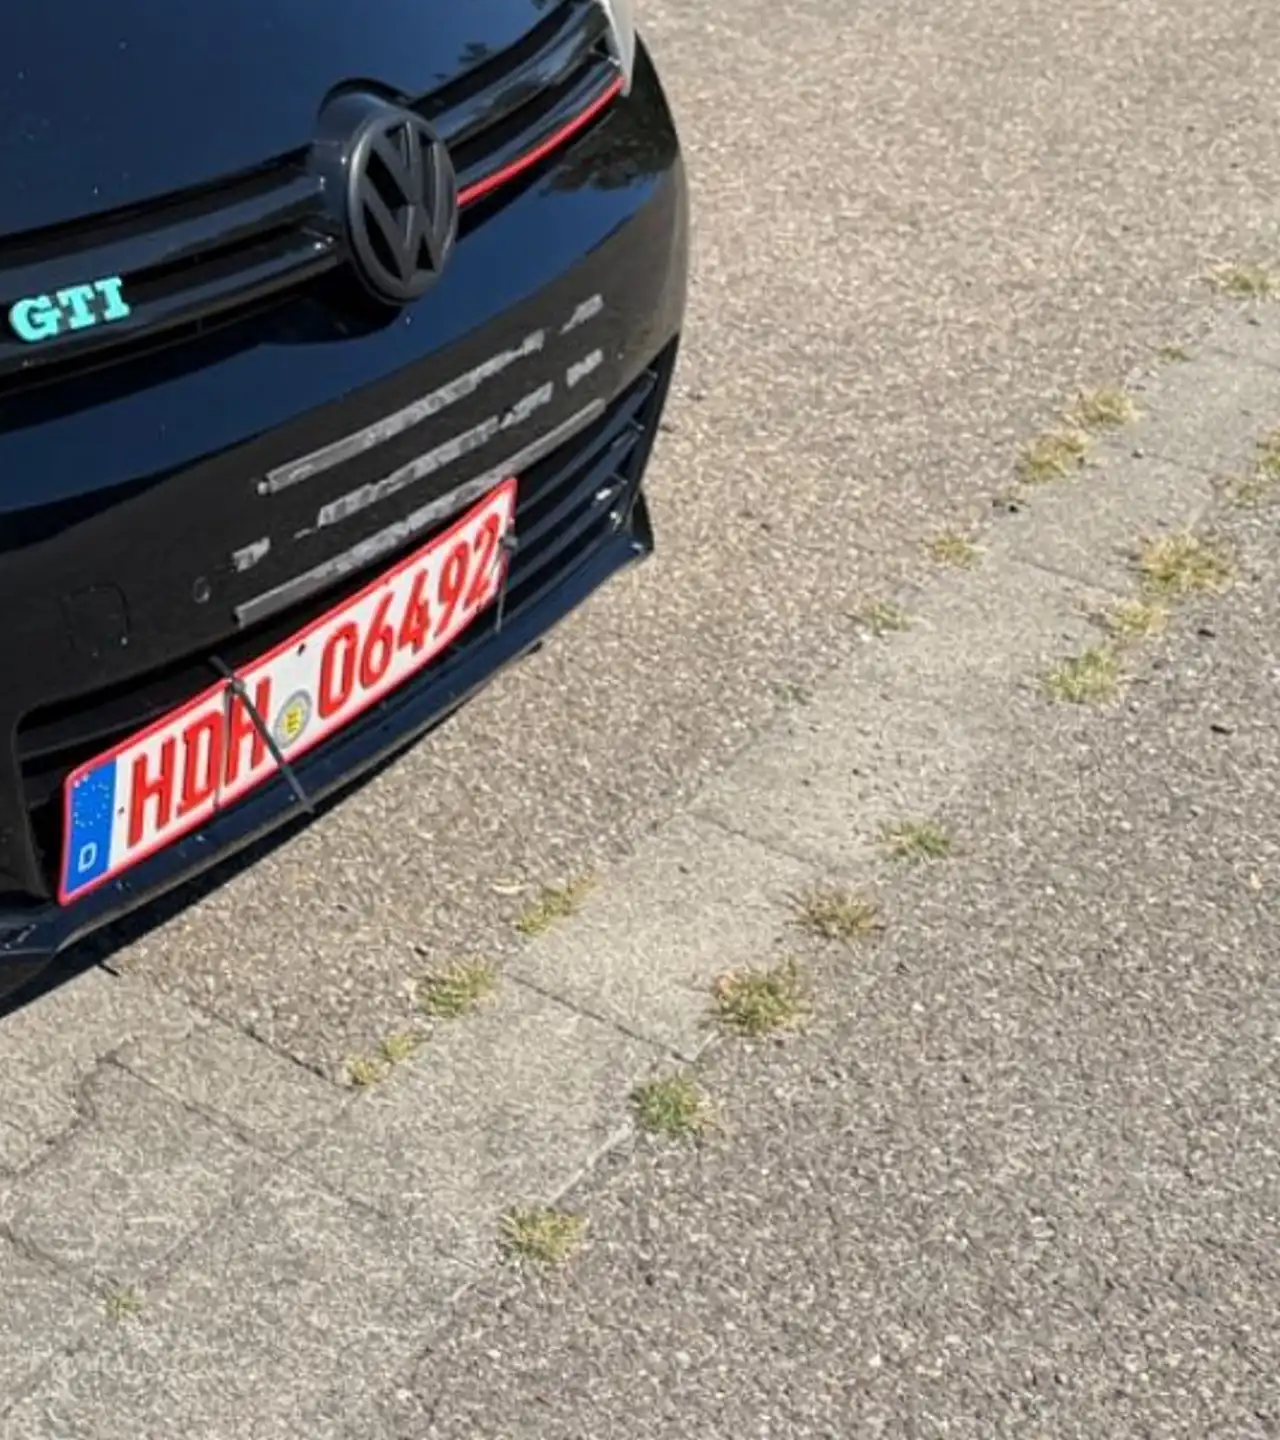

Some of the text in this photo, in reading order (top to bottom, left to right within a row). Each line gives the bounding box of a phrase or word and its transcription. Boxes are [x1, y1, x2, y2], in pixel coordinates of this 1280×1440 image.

[350, 116, 456, 298] VW
[10, 277, 130, 342] GTI
[127, 512, 501, 850] HDH 06492
[77, 842, 98, 874] D
